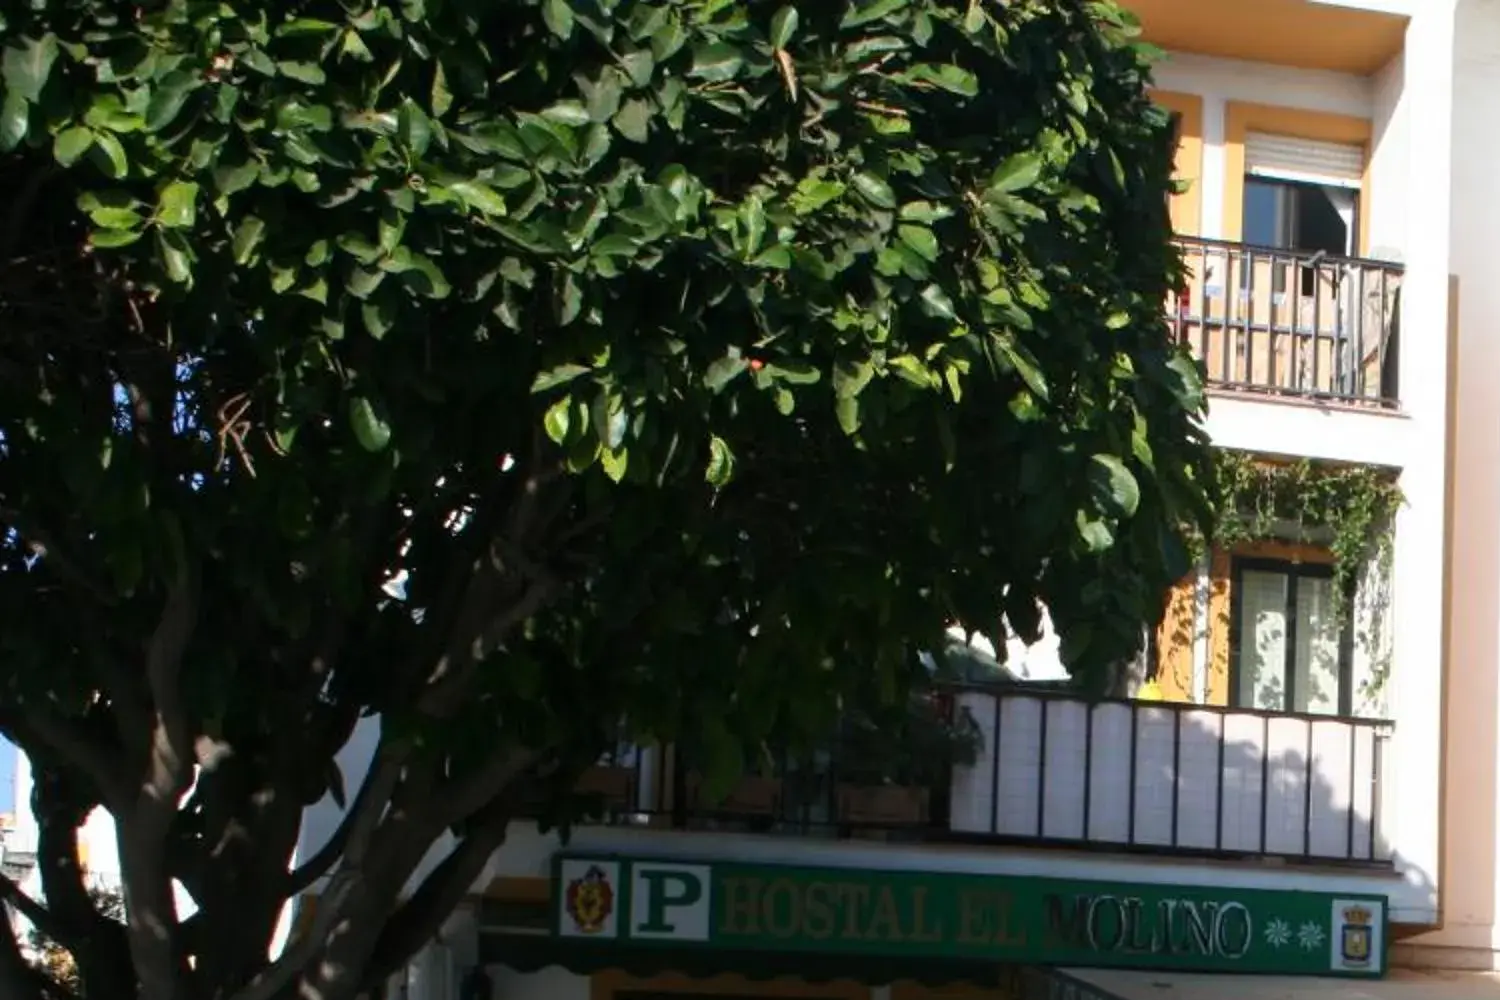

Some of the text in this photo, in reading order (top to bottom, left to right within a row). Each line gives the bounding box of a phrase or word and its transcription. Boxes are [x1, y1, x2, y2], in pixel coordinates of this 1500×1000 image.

[638, 870, 702, 934] P
[720, 877, 1254, 960] HOSTAL EL MOLINO
